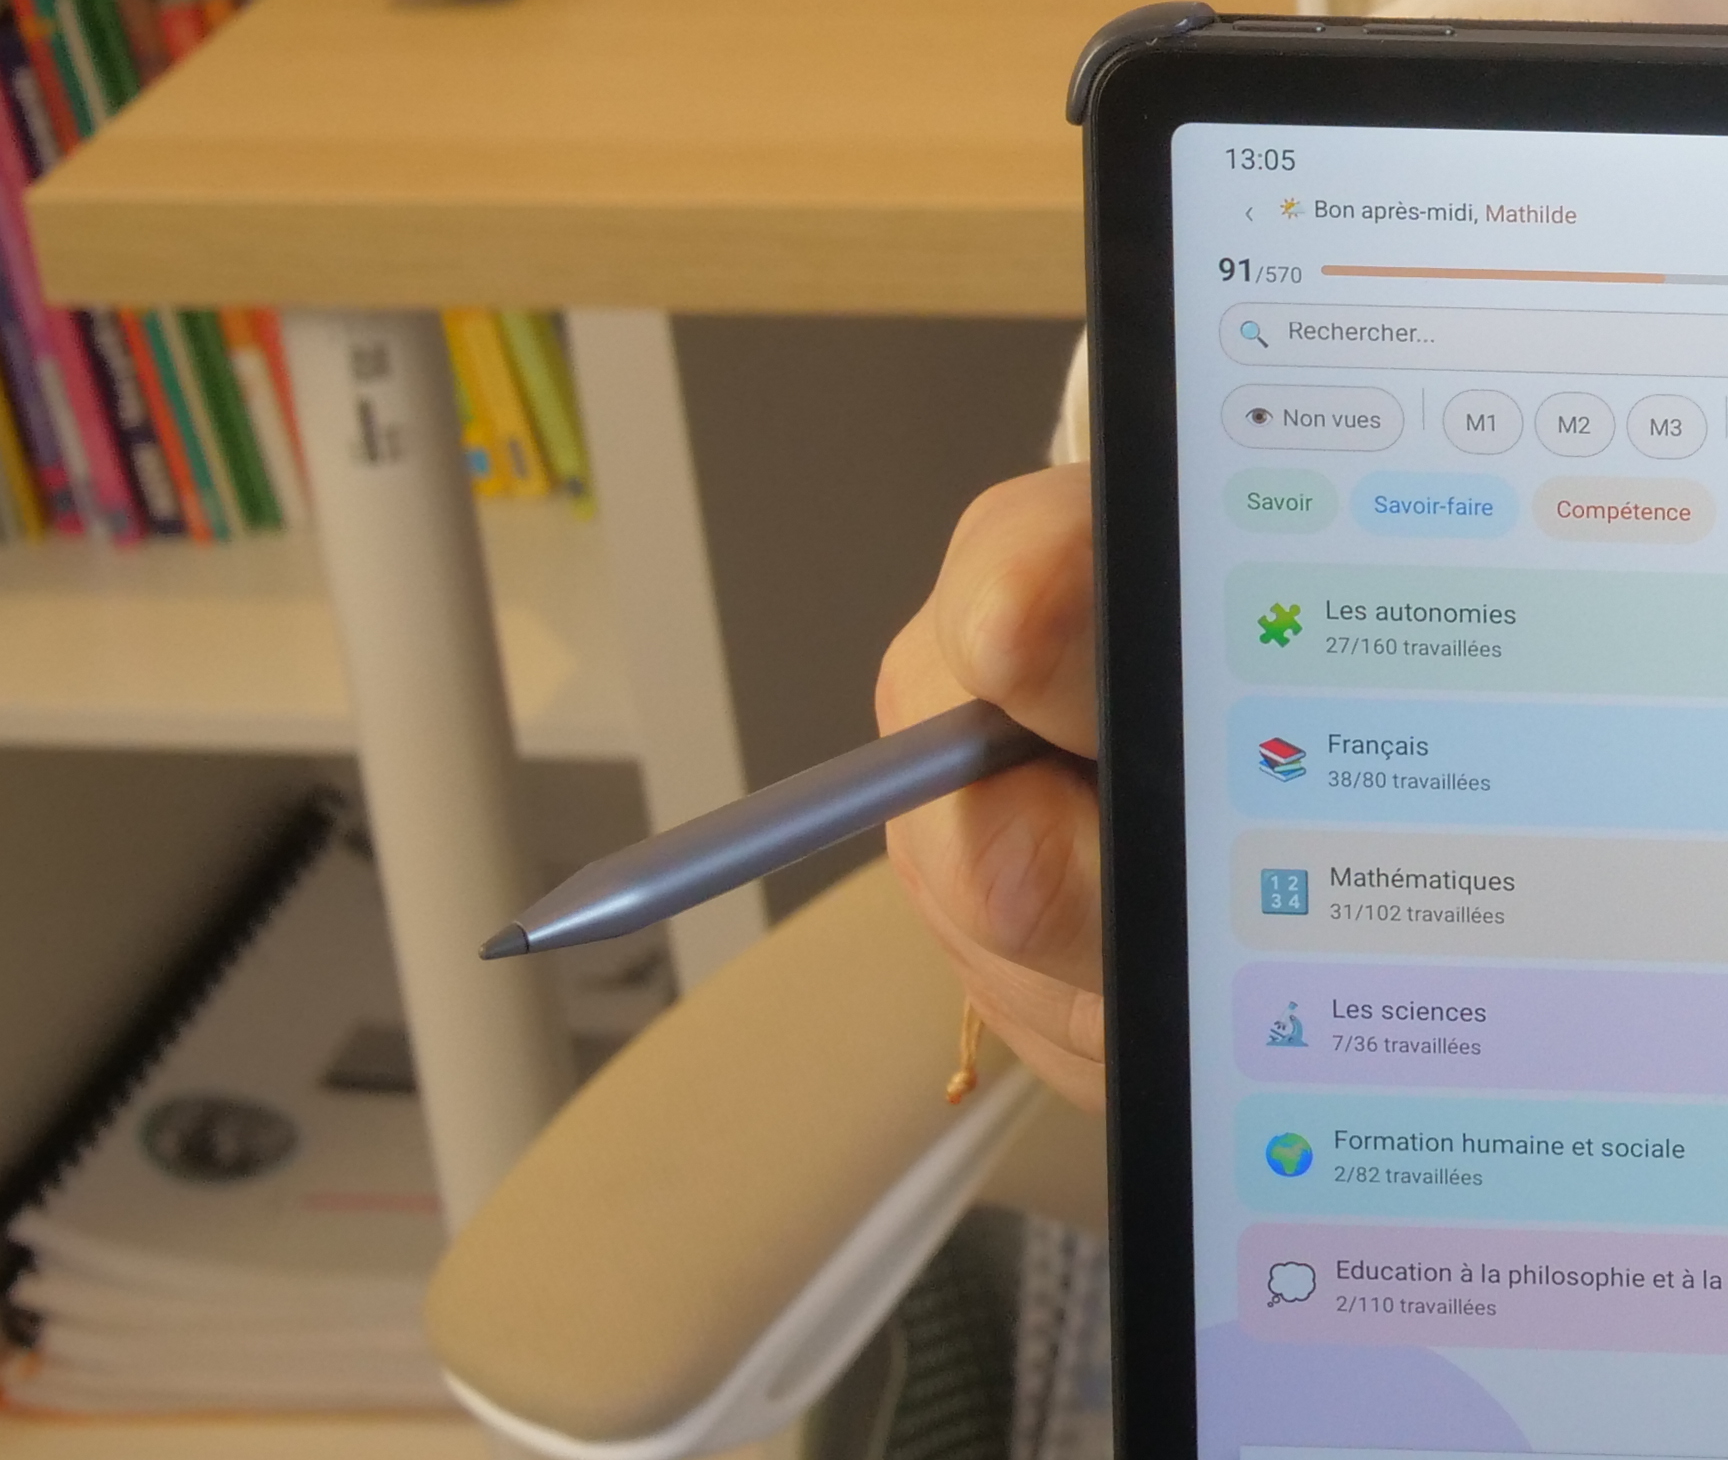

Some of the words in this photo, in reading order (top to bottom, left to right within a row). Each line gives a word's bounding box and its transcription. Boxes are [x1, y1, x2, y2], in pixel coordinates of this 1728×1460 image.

[1226, 148, 1295, 171] 13:05
[1315, 200, 1354, 218] Bon
[1362, 201, 1478, 224] après-midi,
[1486, 204, 1576, 224] Mathilde
[1284, 409, 1325, 427] Non
[1332, 414, 1381, 429] vues
[1467, 414, 1495, 431] M1
[1559, 416, 1590, 434] M2
[1650, 418, 1682, 436] M3
[1248, 492, 1312, 511] Savoir
[1375, 495, 1493, 516] Savoir-faire
[1557, 500, 1690, 524] Compétence
[1326, 600, 1366, 620] Les
[1376, 604, 1516, 624] autonomies
[1326, 637, 1397, 655] 27/160
[1403, 640, 1501, 657] travaillées
[1329, 734, 1428, 760] Français
[1328, 770, 1386, 788] 38/80
[1392, 773, 1490, 791] travaillées
[1331, 867, 1515, 895] Mathématiques
[1330, 903, 1401, 921] 31/102
[1407, 906, 1504, 924] travaillées
[1333, 999, 1372, 1019] Les
[1382, 1001, 1486, 1022] sciences
[1333, 1035, 1378, 1052] 7/36
[1384, 1038, 1481, 1055] travaillées
[1335, 1130, 1453, 1152] Formation
[1463, 1133, 1564, 1155] humaine
[1572, 1139, 1593, 1156] et
[1602, 1139, 1685, 1159] sociale
[1335, 1166, 1380, 1183] 2/82
[1386, 1168, 1482, 1186] travaillées
[1337, 1260, 1451, 1282] Education
[1461, 1263, 1472, 1283] à
[1482, 1264, 1500, 1283] la
[1509, 1264, 1645, 1291] philosophie
[1653, 1271, 1674, 1288] et
[1682, 1269, 1694, 1289] à
[1703, 1270, 1722, 1290] la
[1336, 1295, 1394, 1313] 2/110
[1400, 1299, 1496, 1316] travaillées
